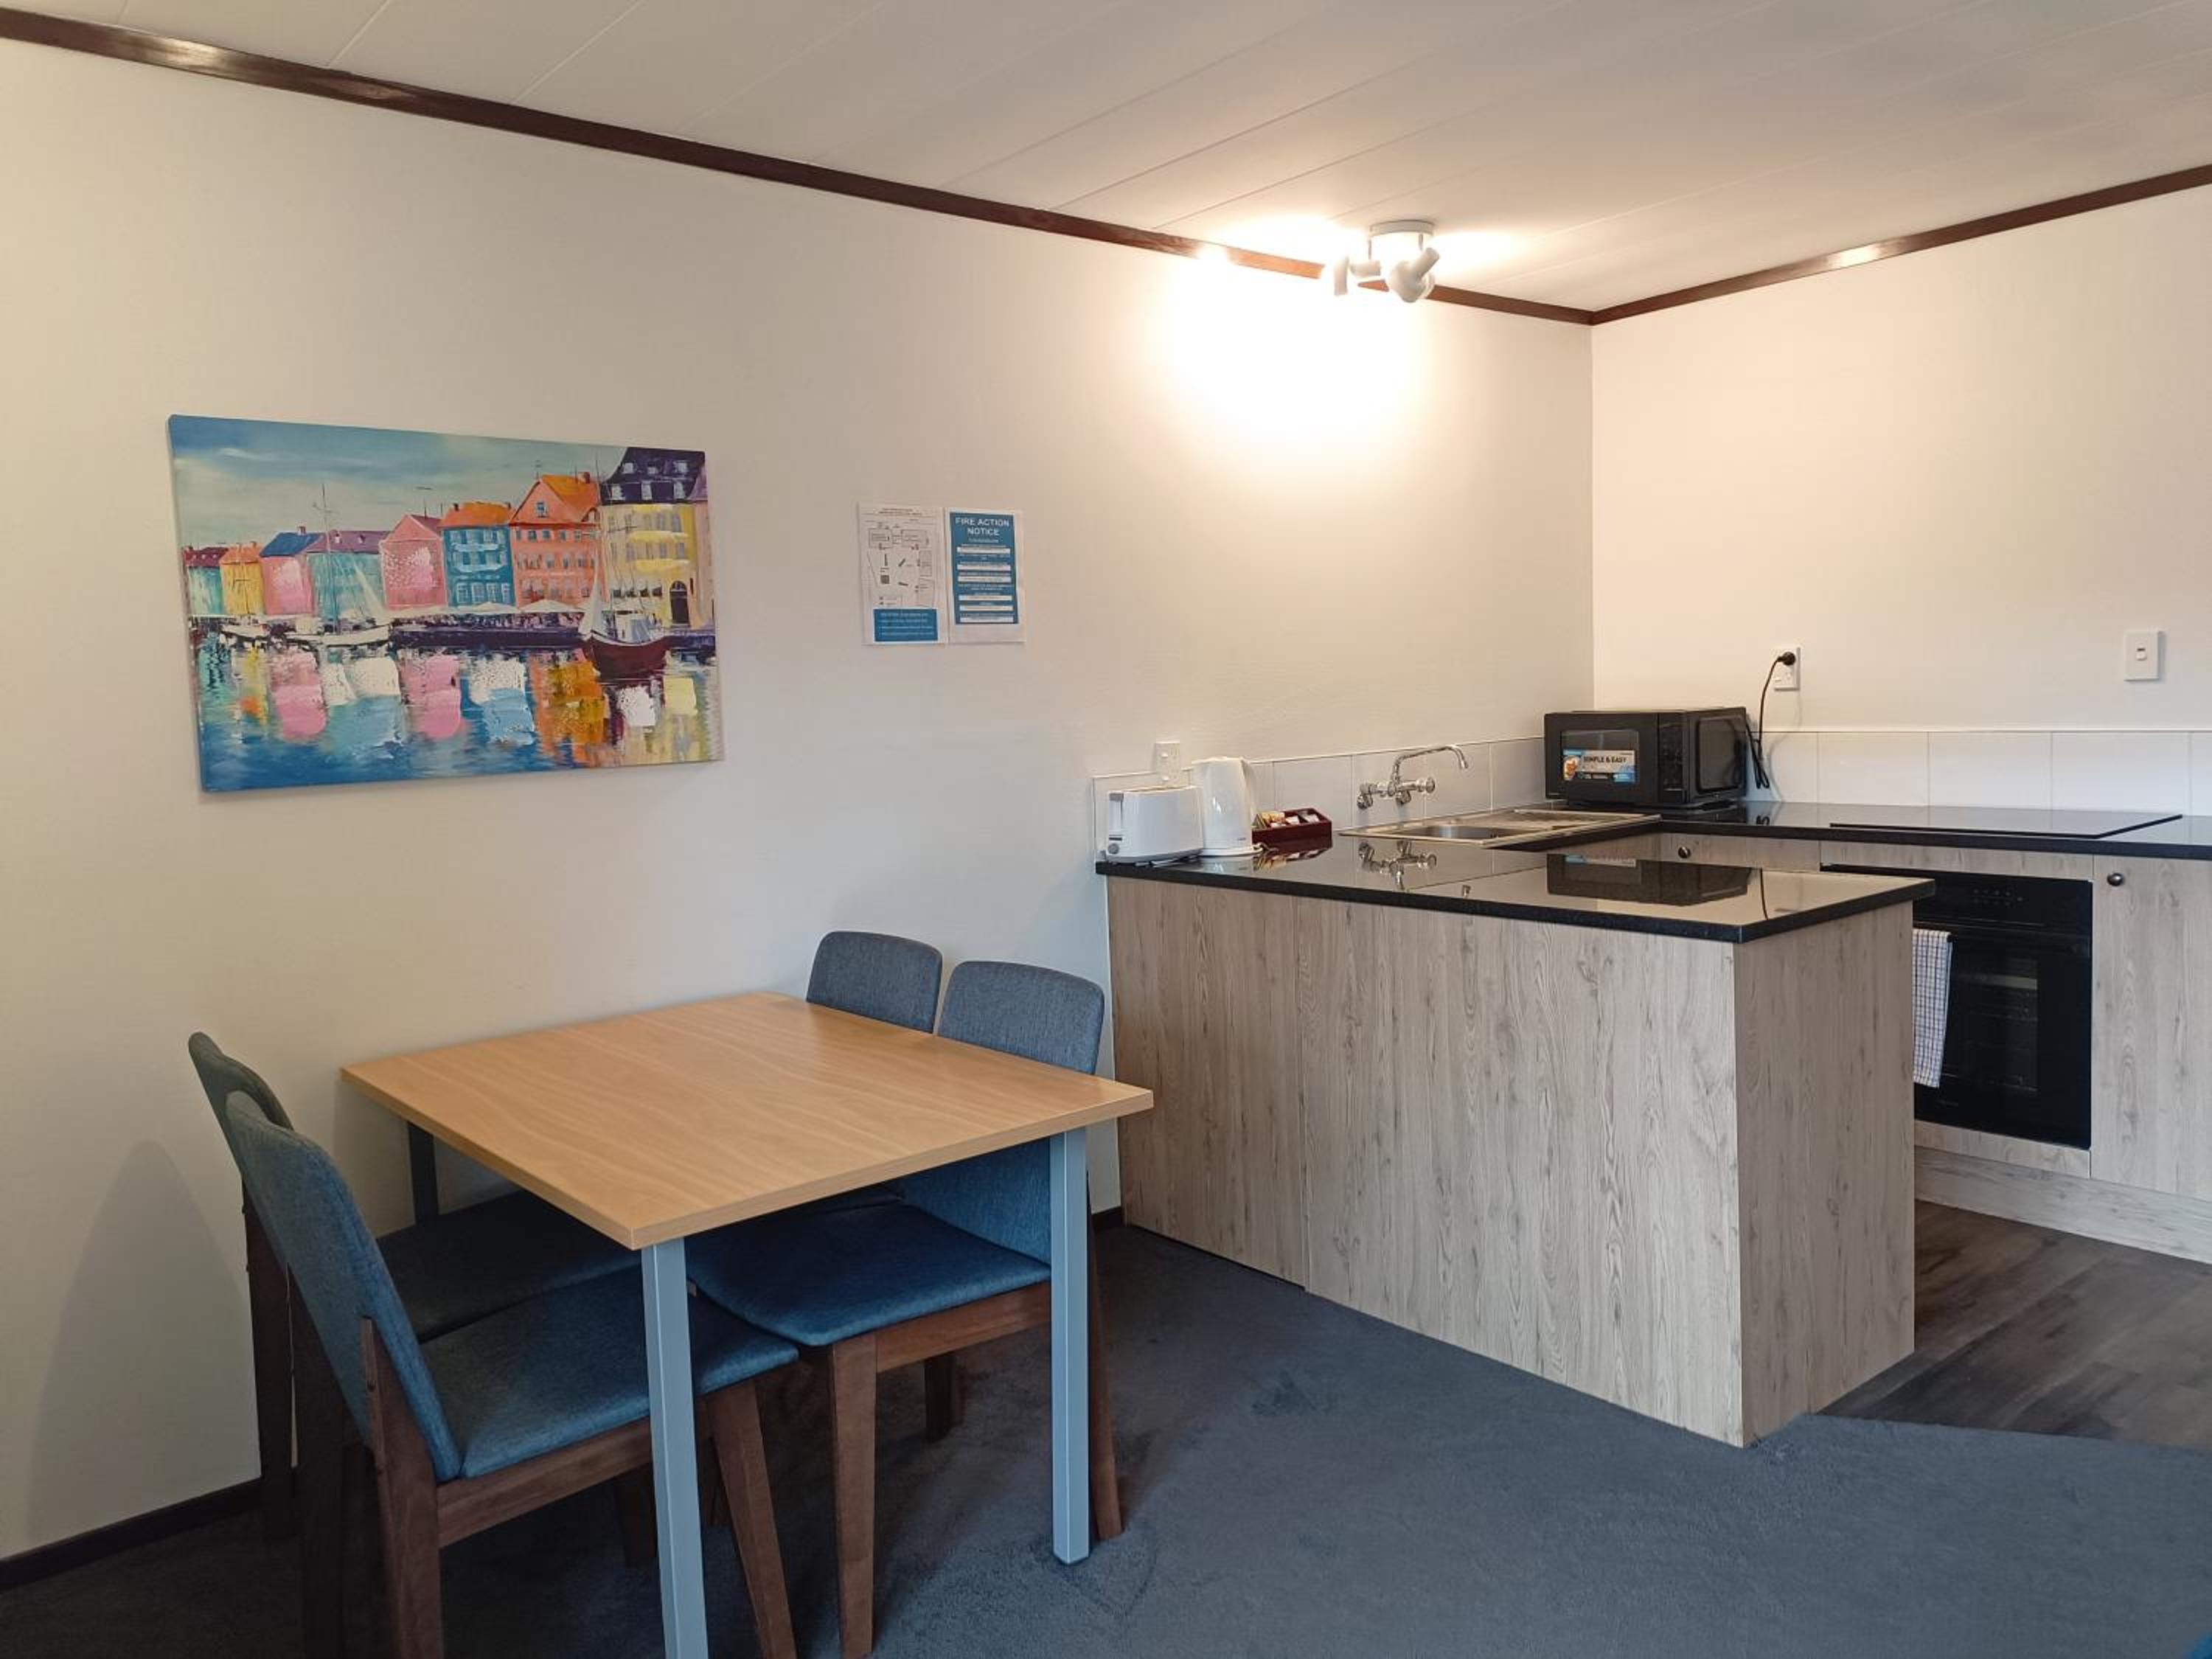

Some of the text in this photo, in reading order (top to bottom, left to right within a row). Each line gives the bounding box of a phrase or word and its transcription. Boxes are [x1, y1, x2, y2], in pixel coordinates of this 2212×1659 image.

[955, 518, 1009, 527] FIRE ACTION
[967, 527, 1000, 536] NOTICE
